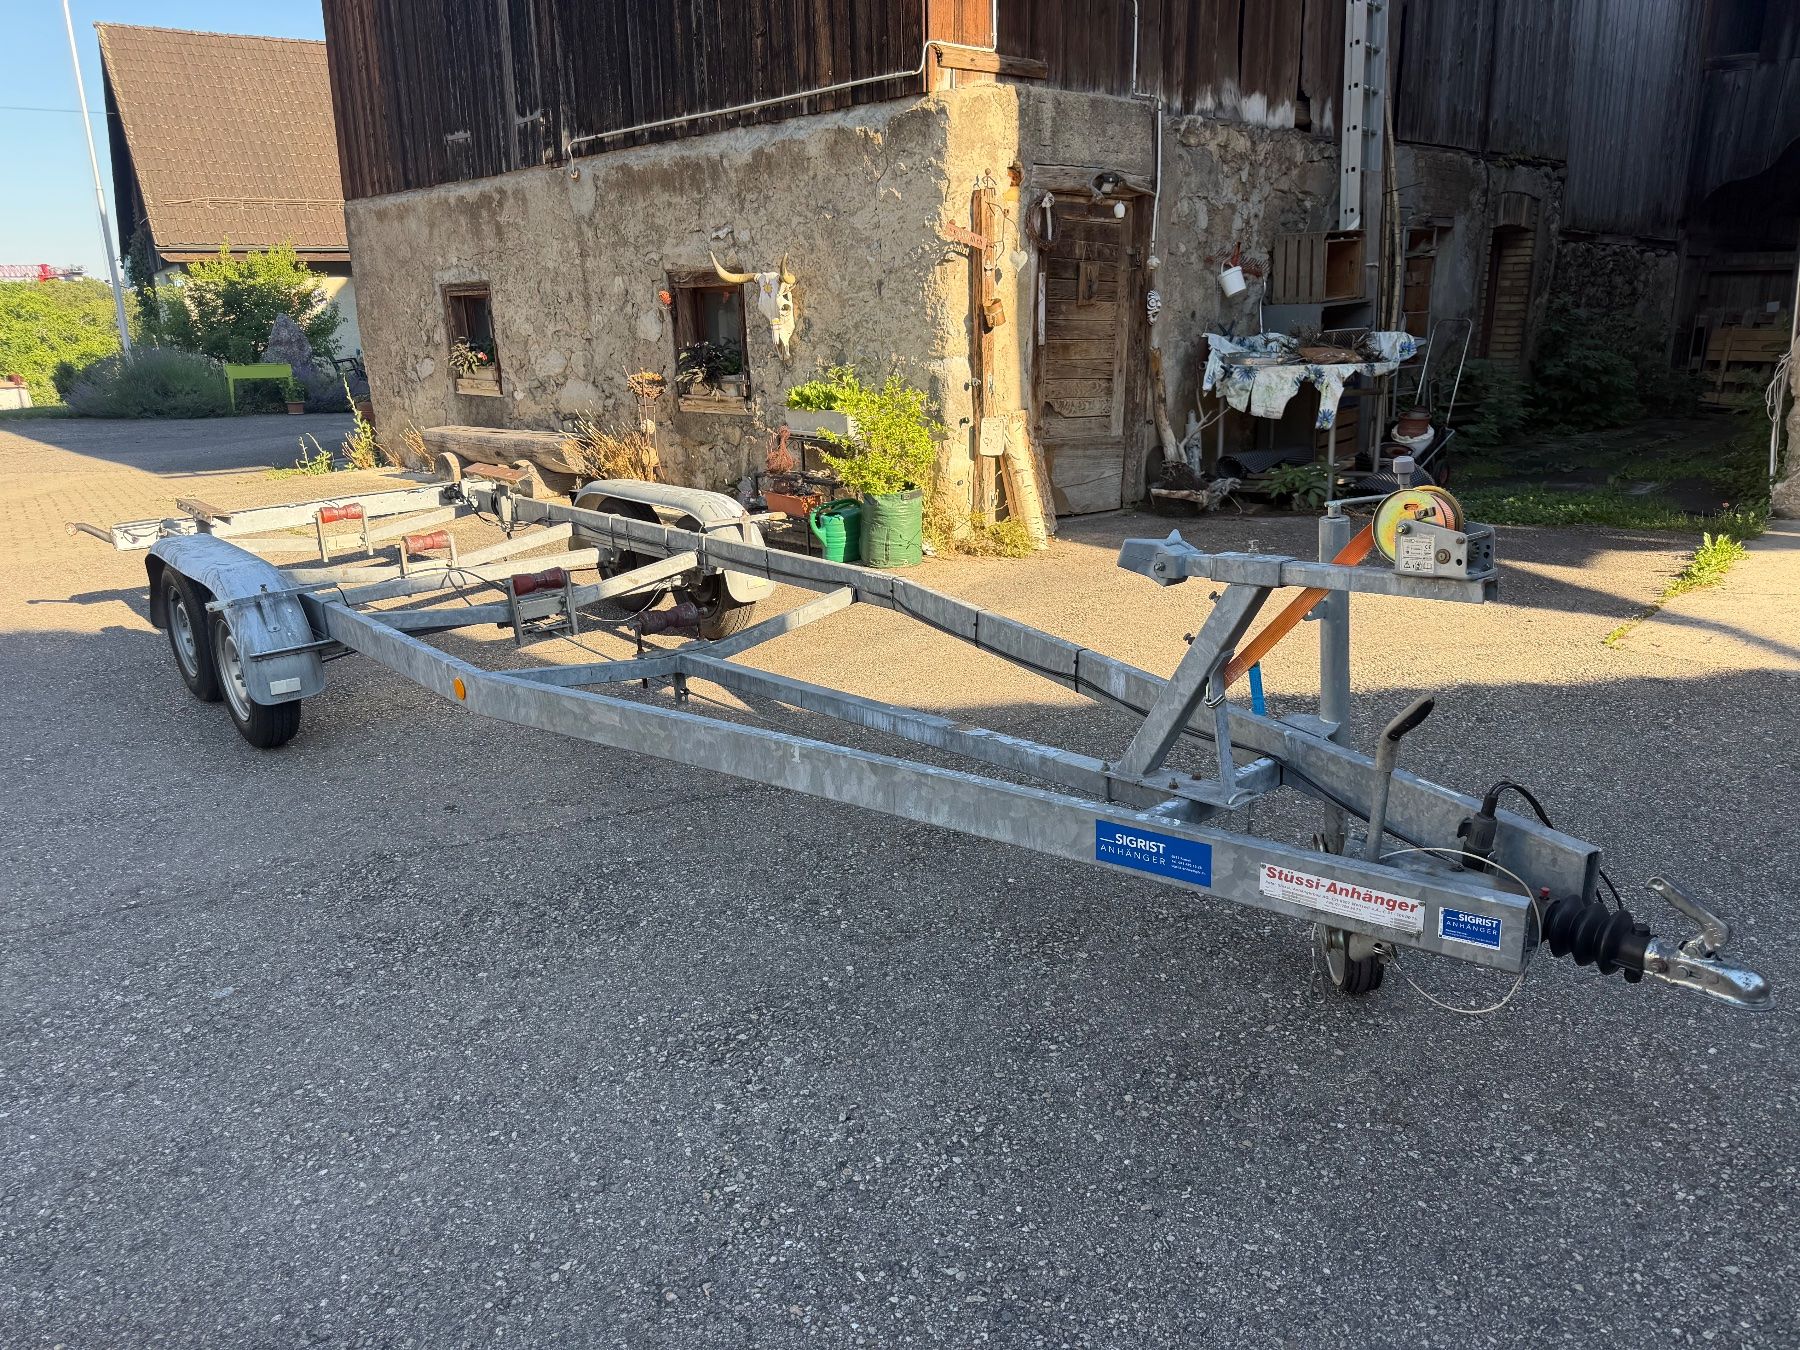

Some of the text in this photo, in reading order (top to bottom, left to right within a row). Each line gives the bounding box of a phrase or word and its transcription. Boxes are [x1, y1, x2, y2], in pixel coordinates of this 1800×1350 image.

[1115, 833, 1166, 854] SIGRIST
[1100, 844, 1166, 866] ANHÄNGER
[1266, 866, 1419, 913] Stüssi-Anhänger
[1458, 913, 1498, 928] SIGRIST
